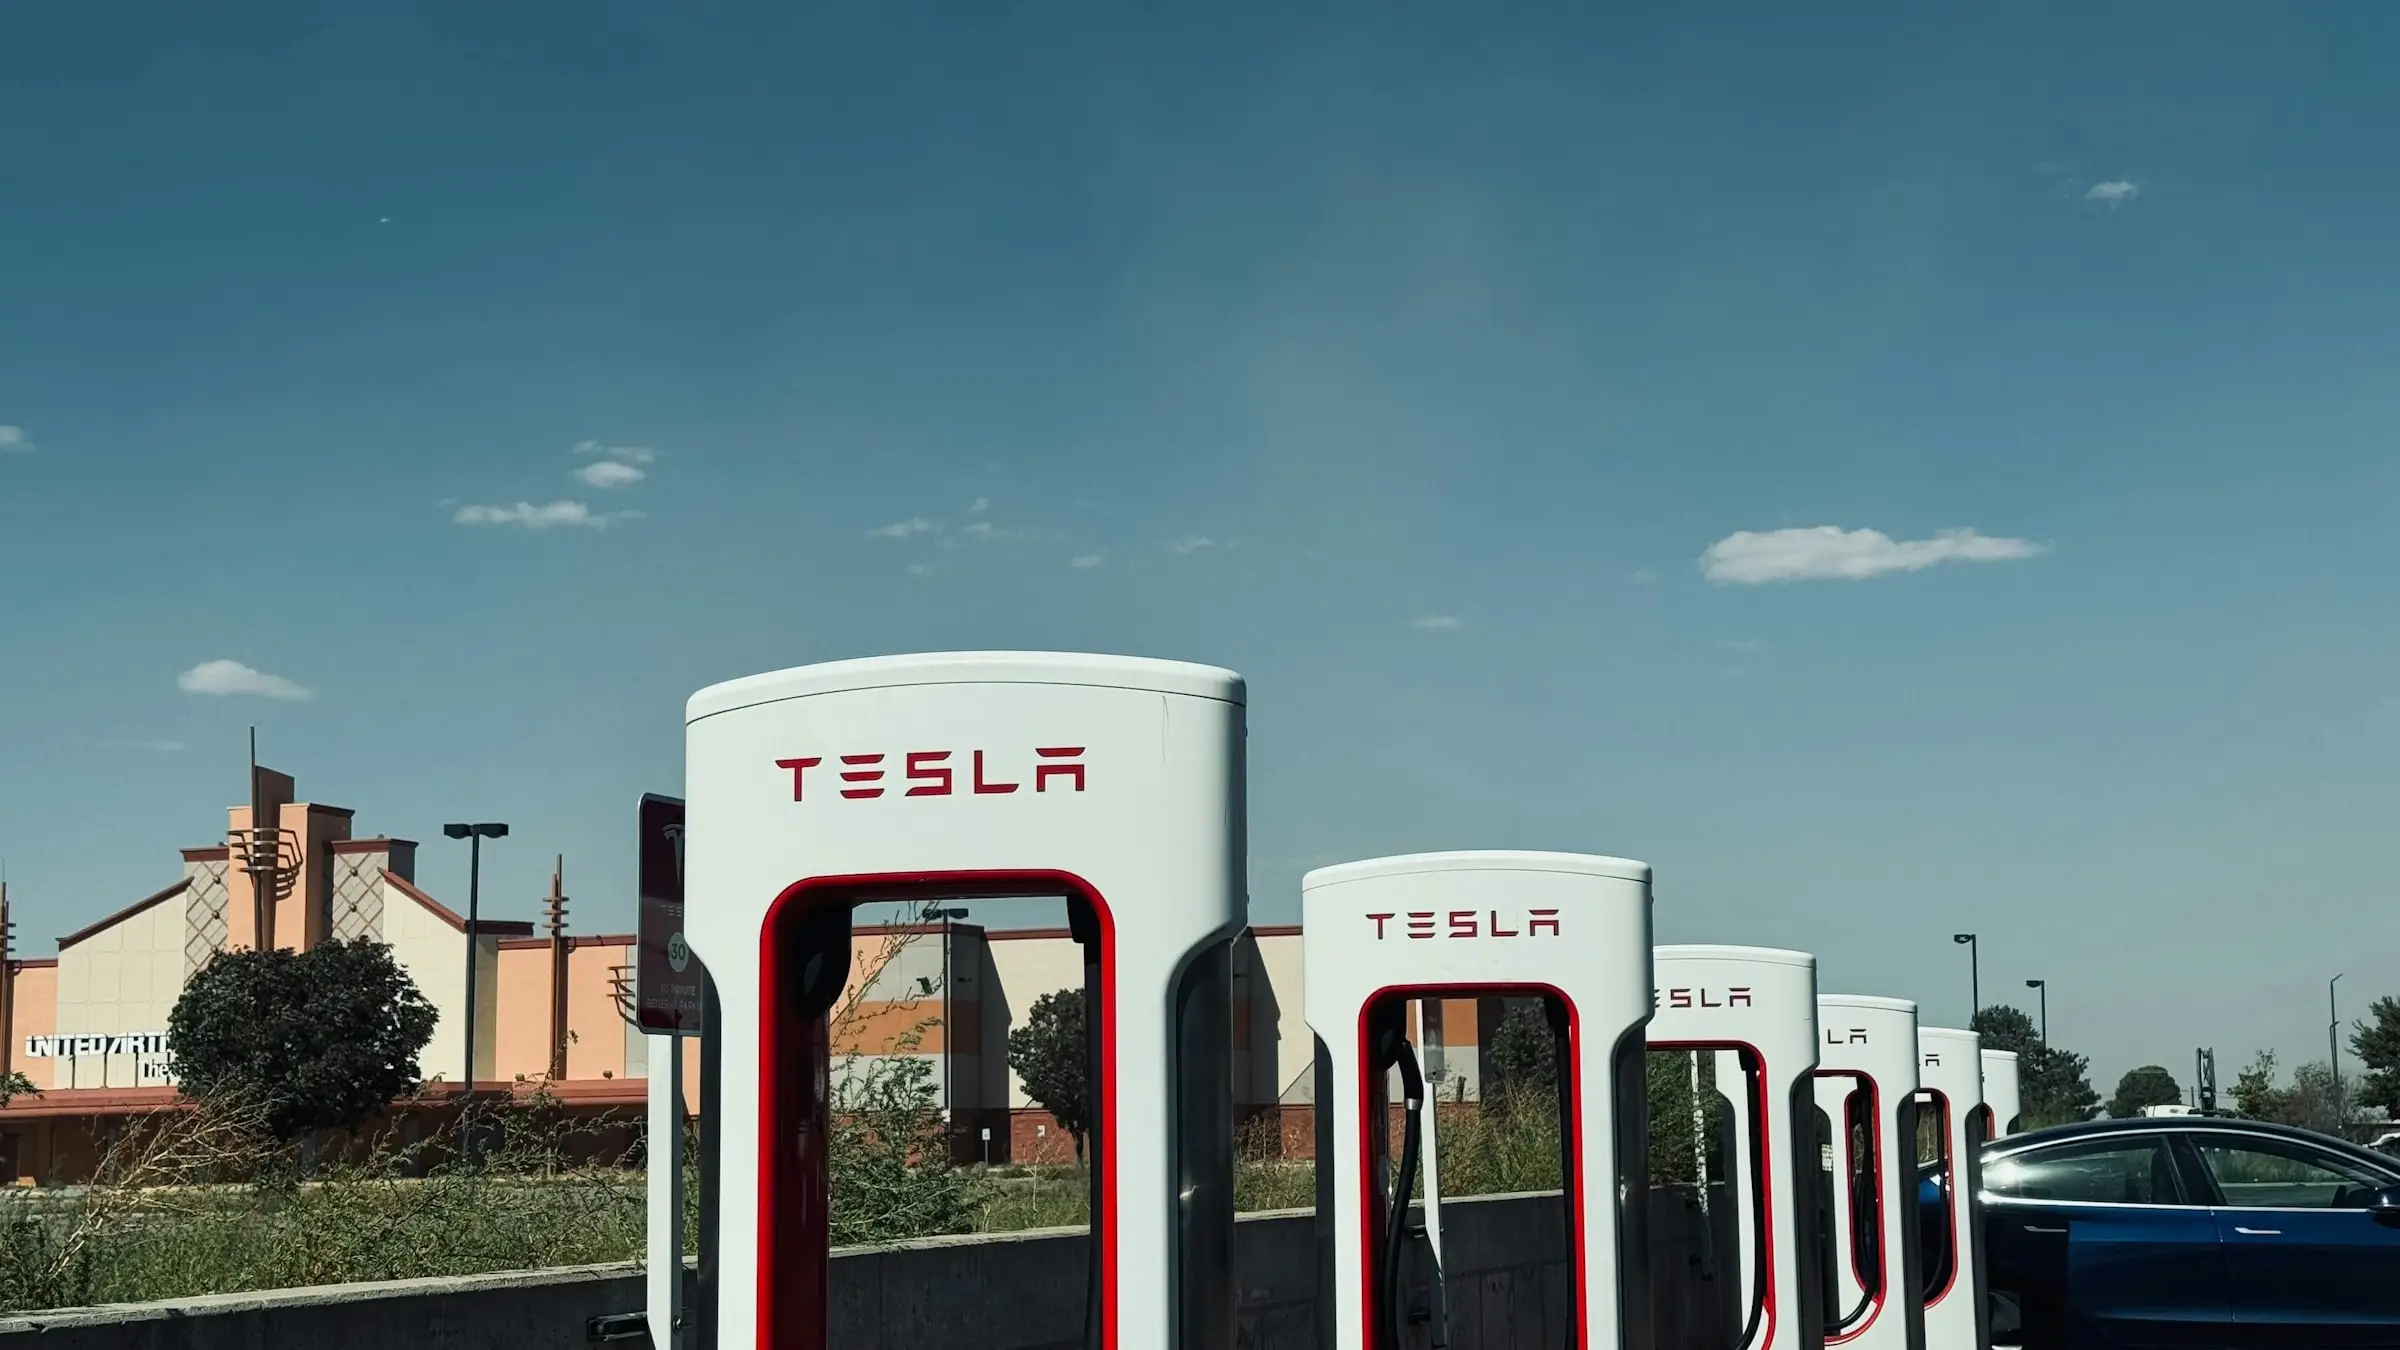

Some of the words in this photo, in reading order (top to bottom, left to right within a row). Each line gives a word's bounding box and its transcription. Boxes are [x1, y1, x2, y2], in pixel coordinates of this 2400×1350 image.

[775, 747, 1086, 802] TESLA
[1365, 909, 1560, 940] TESLA
[671, 943, 686, 961] 30
[25, 1033, 107, 1057] UNITED
[138, 1058, 172, 1080] The
